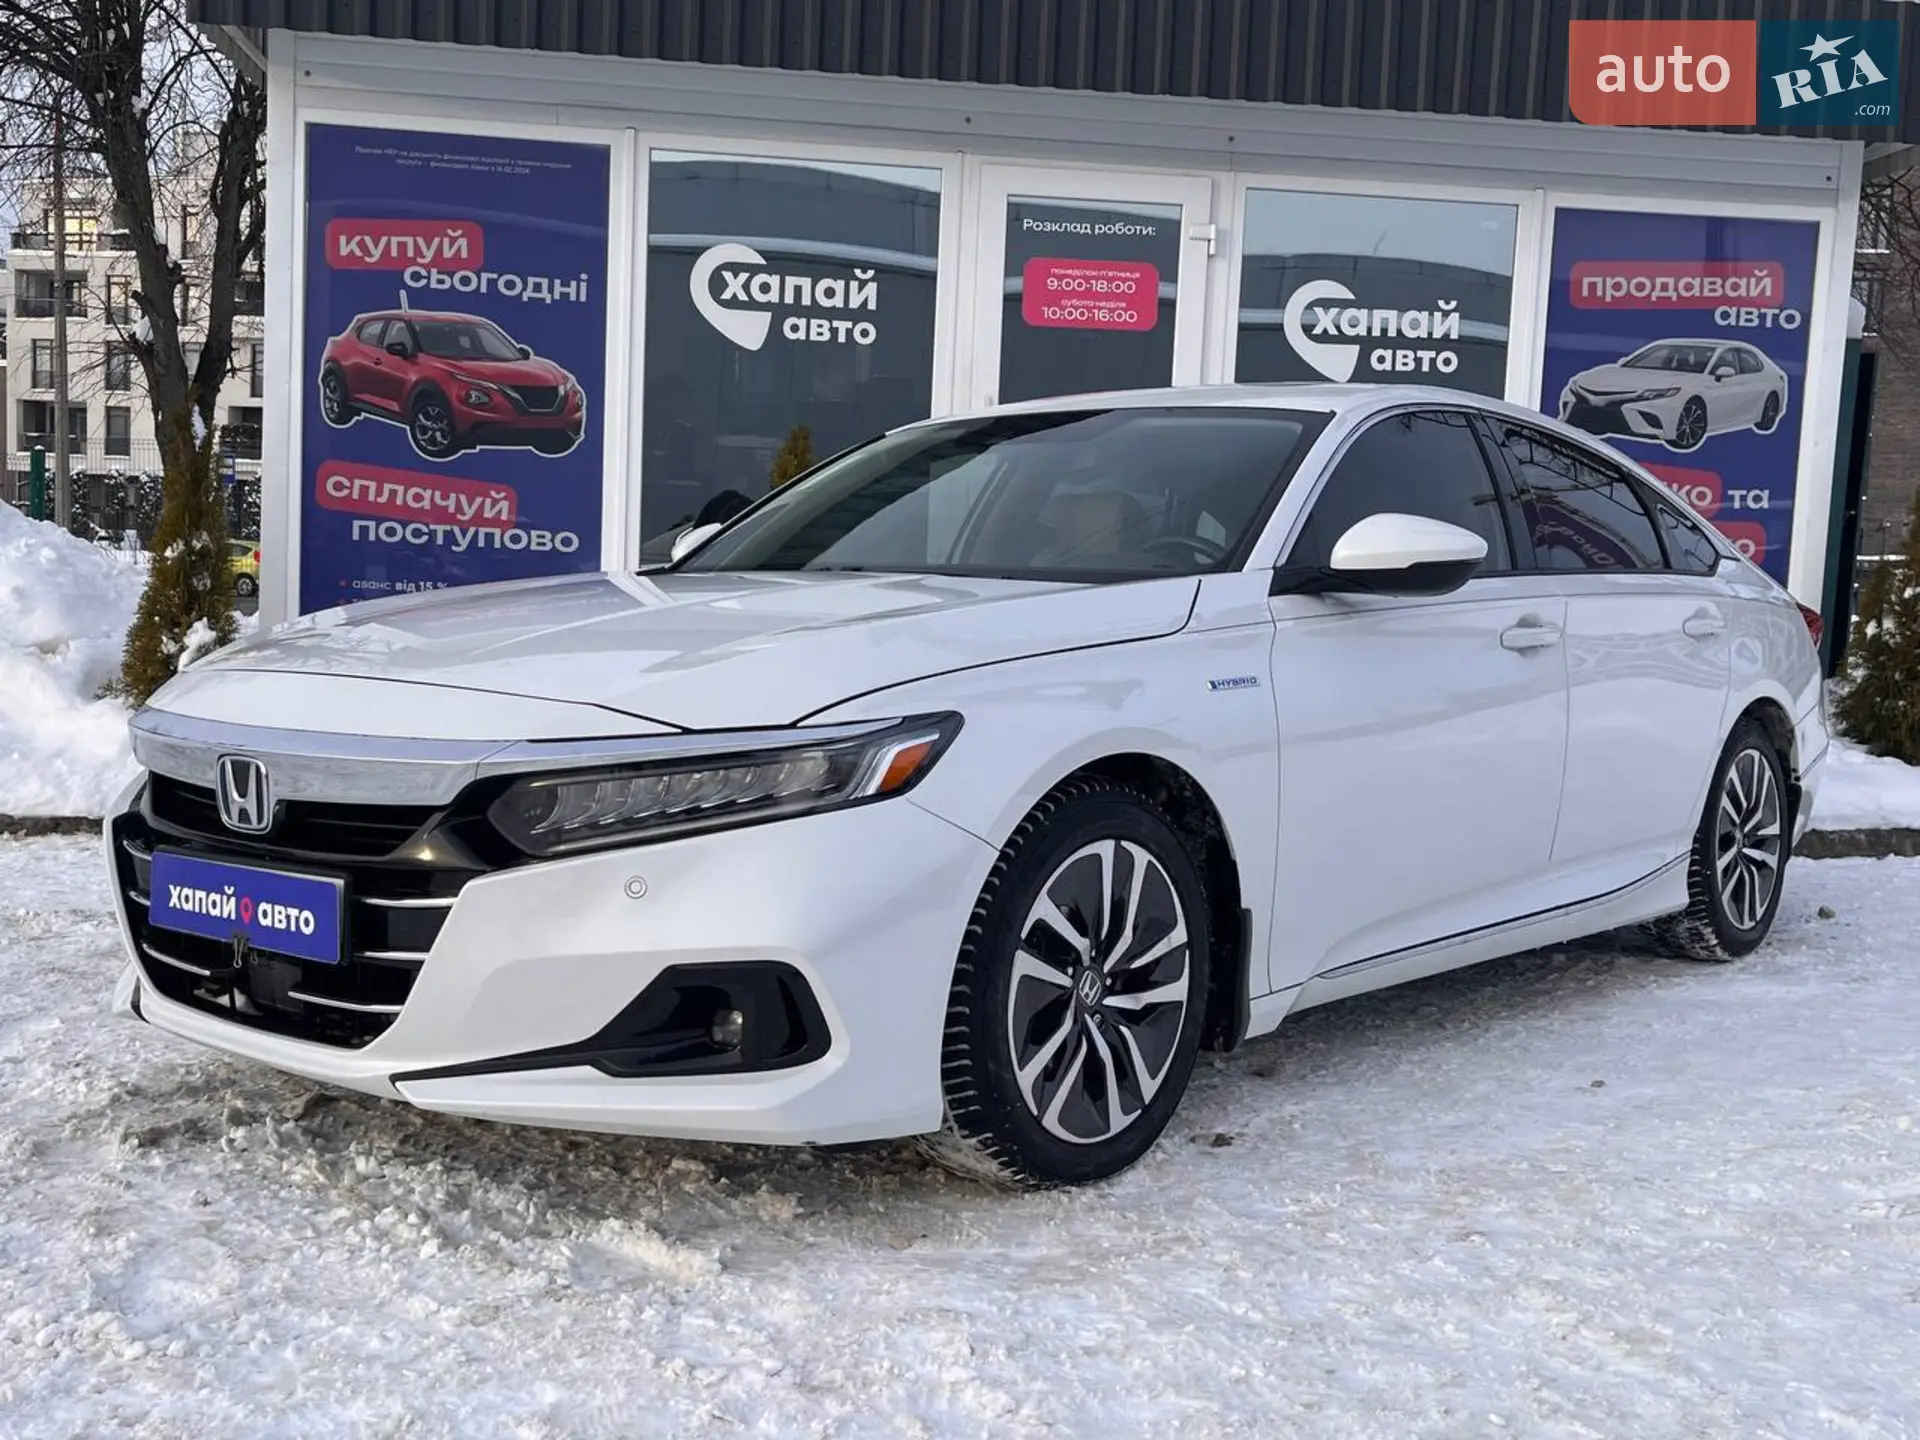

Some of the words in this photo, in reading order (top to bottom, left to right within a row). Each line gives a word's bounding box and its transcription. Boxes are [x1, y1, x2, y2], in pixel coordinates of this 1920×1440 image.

[1023, 219, 1091, 234] Розклад
[1095, 223, 1156, 235] роботи:
[338, 228, 468, 263] купуй
[404, 266, 587, 303] сьогодні
[720, 268, 878, 311] хапай
[1047, 278, 1135, 293] 9:00-18:00
[1581, 269, 1773, 303] продавай
[1042, 306, 1137, 323] 10:00-16:00
[1312, 300, 1460, 339] хапай
[1714, 306, 1801, 330] авто
[782, 317, 878, 346] авто
[1370, 347, 1458, 373] авто
[326, 475, 509, 521] сплачуй
[1728, 489, 1769, 509] та
[352, 519, 580, 552] поступово
[352, 579, 392, 590] аванс
[395, 579, 417, 593] від
[420, 581, 433, 592] 15
[168, 884, 237, 920] хапай
[257, 900, 316, 935] авто
